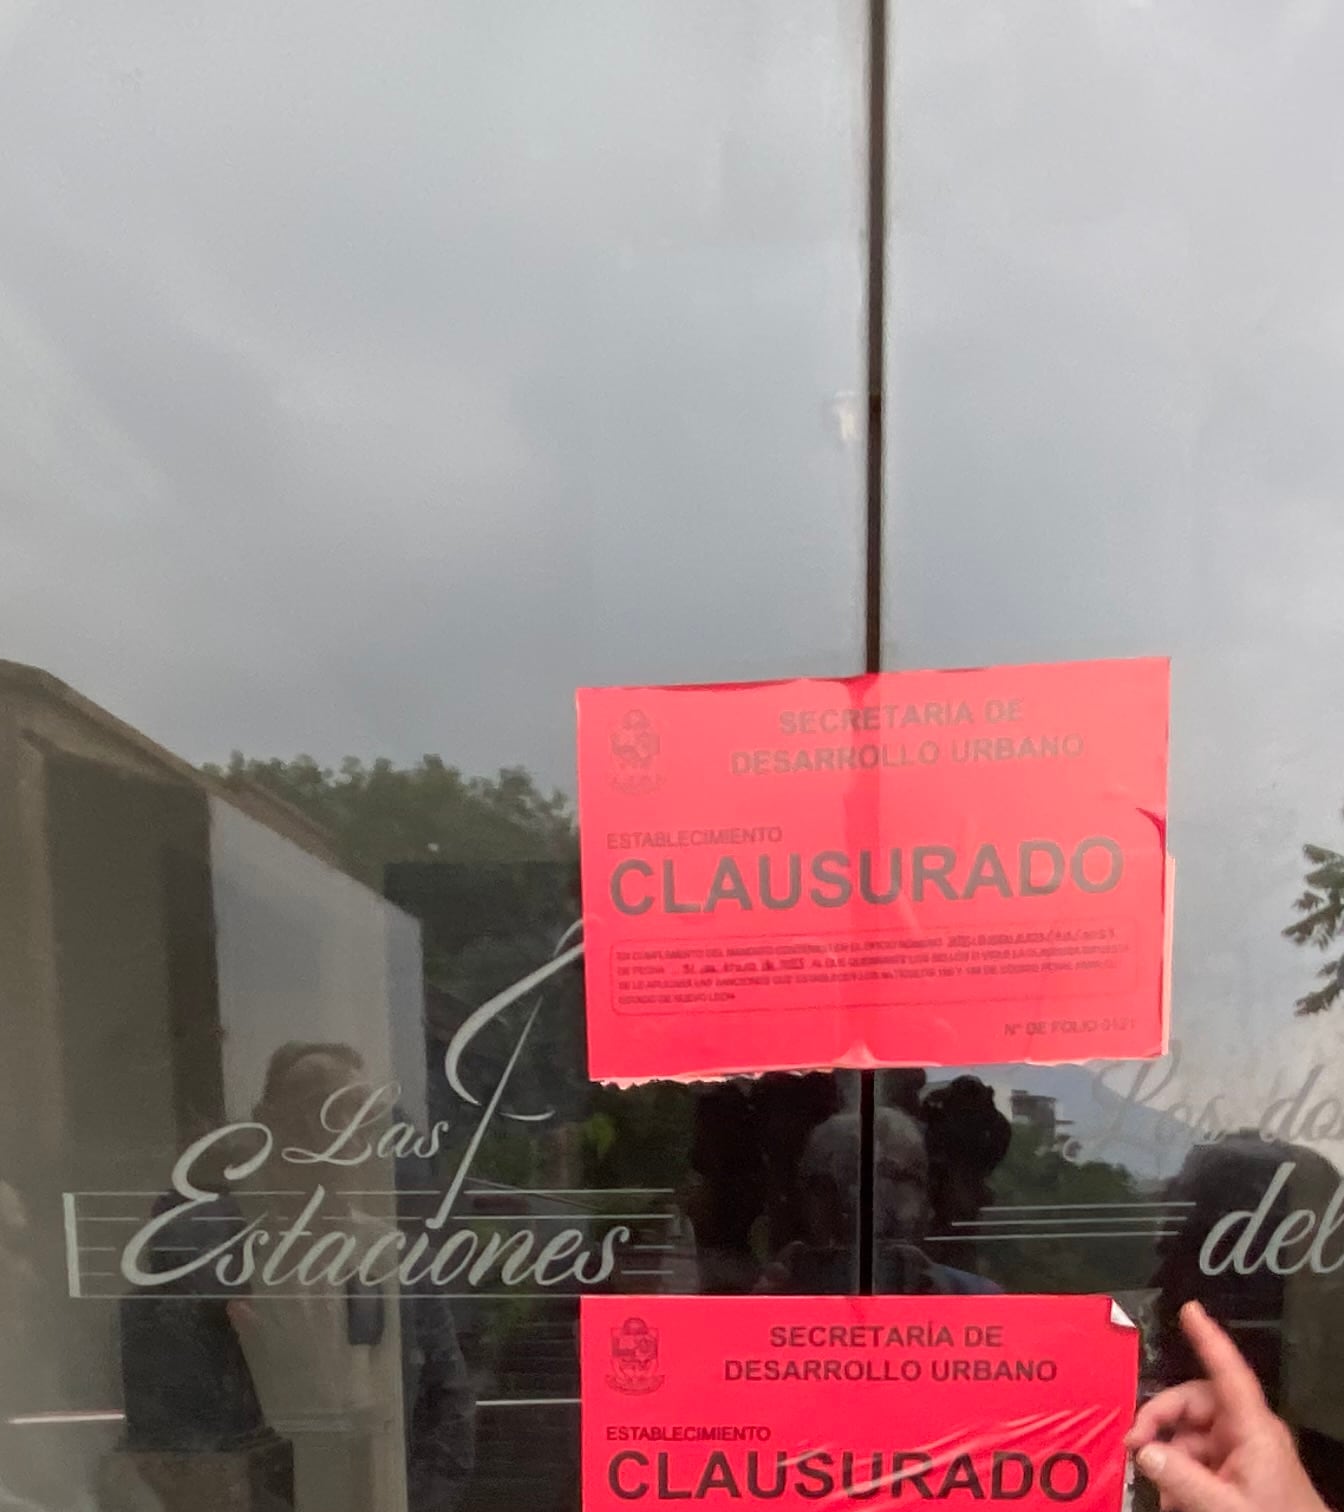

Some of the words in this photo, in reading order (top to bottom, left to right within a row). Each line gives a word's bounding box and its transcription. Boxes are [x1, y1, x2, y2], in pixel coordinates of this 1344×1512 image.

[984, 698, 1025, 724] DE
[731, 741, 941, 776] DESARROLLO
[952, 734, 1085, 765] URBANO
[606, 826, 784, 849] ESTABLECIMIENTO
[609, 836, 1125, 916] CLAUSURADO
[281, 1081, 449, 1166] Las
[120, 1122, 630, 1287] Estaciones
[769, 1319, 955, 1348] SECRETARÍA
[964, 1325, 1004, 1348] DE
[724, 1359, 922, 1383] DESARROLLO
[931, 1359, 1058, 1383] URBANO
[606, 1425, 771, 1442] ESTABLECIMIENTO
[607, 1450, 1090, 1501] CLAUSURADO
